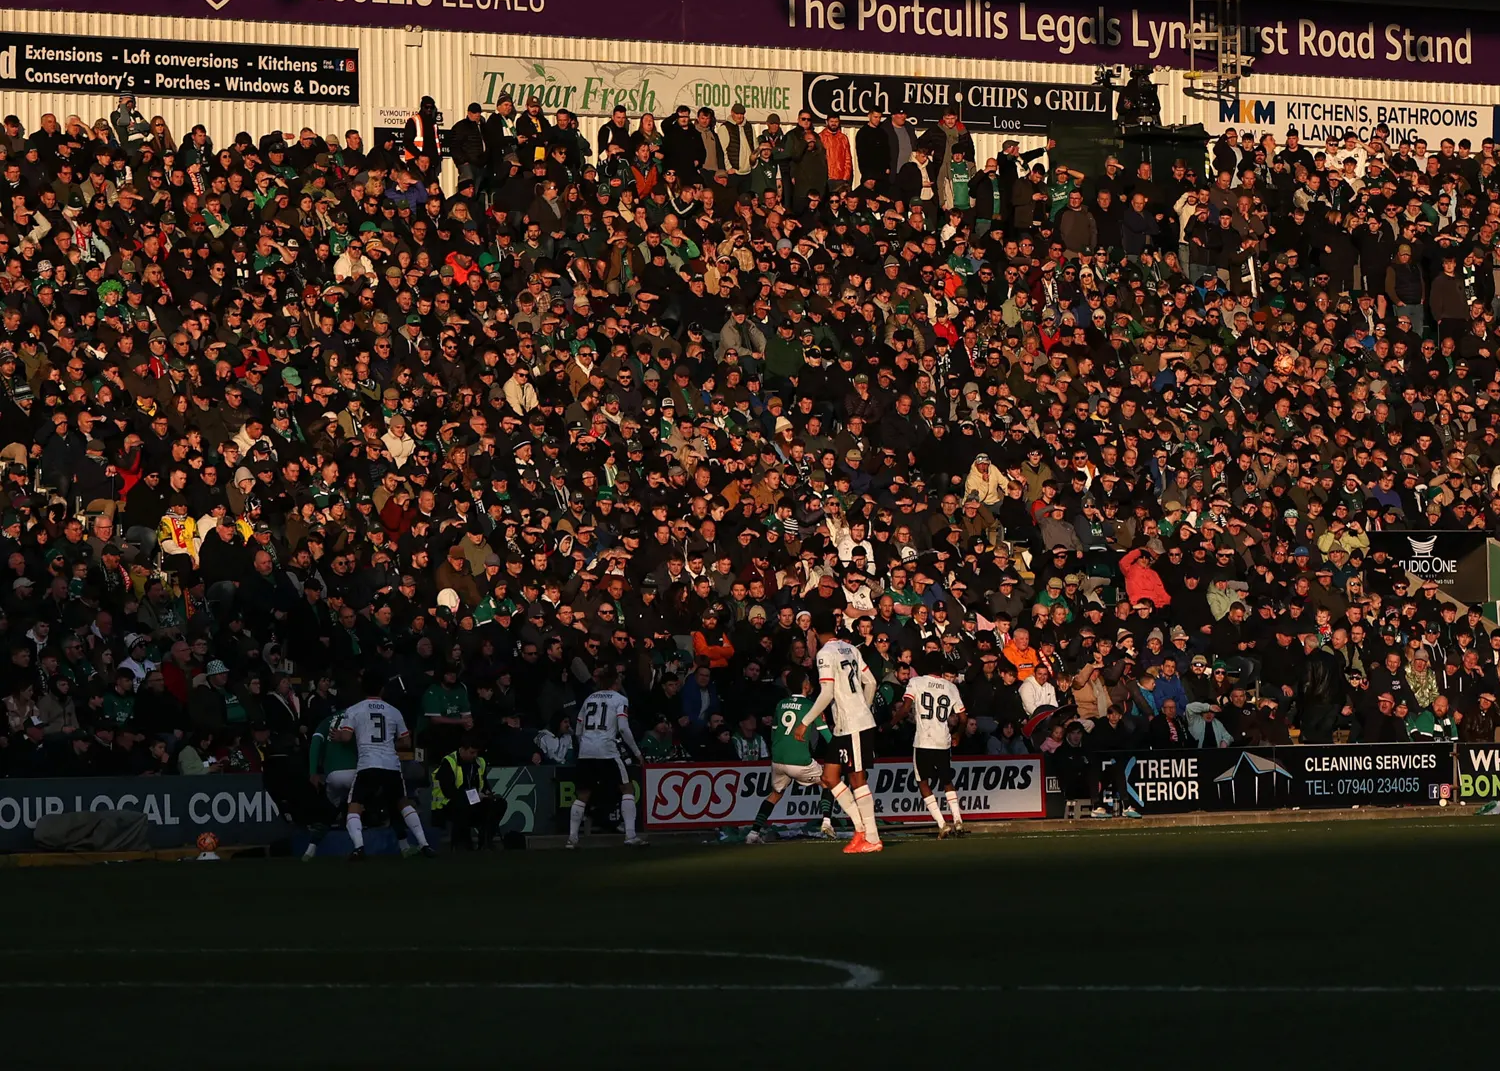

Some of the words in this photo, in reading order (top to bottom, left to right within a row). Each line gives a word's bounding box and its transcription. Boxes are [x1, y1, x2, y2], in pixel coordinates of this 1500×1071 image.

[1019, 2, 1122, 55] Legals
[1299, 19, 1375, 59] Road
[1385, 24, 1472, 65] Stand
[25, 44, 103, 64] Extensions
[123, 49, 151, 65] Loft
[155, 52, 239, 69] conversions
[258, 55, 318, 73] Kitchens
[156, 73, 211, 91] Porches
[225, 76, 289, 95] Windows
[294, 80, 304, 95] &
[309, 80, 350, 96] Doors
[580, 76, 656, 112] Fresh
[695, 83, 730, 108] FOOD
[734, 84, 790, 110] SERVICE
[807, 74, 891, 121] Catch
[903, 82, 950, 106] FISH
[967, 85, 1028, 109] CHIPS
[1045, 89, 1107, 113] GRILL
[379, 109, 411, 117] PLYMOUTH
[993, 115, 1021, 129] Looe
[1218, 99, 1276, 125] MKM
[1287, 101, 1373, 126] KITCHENS,
[1376, 106, 1478, 128] BATHROOMS
[1302, 123, 1419, 144] LANDCING
[1398, 559, 1430, 573] TUDIO
[585, 702, 607, 730] 21
[920, 691, 951, 722] 98
[370, 713, 386, 743] 3
[781, 710, 797, 736] 9
[1304, 756, 1373, 772] CLEANING
[1375, 754, 1437, 770] SERVICES
[875, 765, 1034, 793] DECATORS
[1305, 779, 1334, 796] TEL:
[1337, 778, 1374, 795] 07940
[1377, 777, 1420, 794] 234055
[652, 769, 741, 820] SOS
[891, 795, 990, 813] COMECIAL
